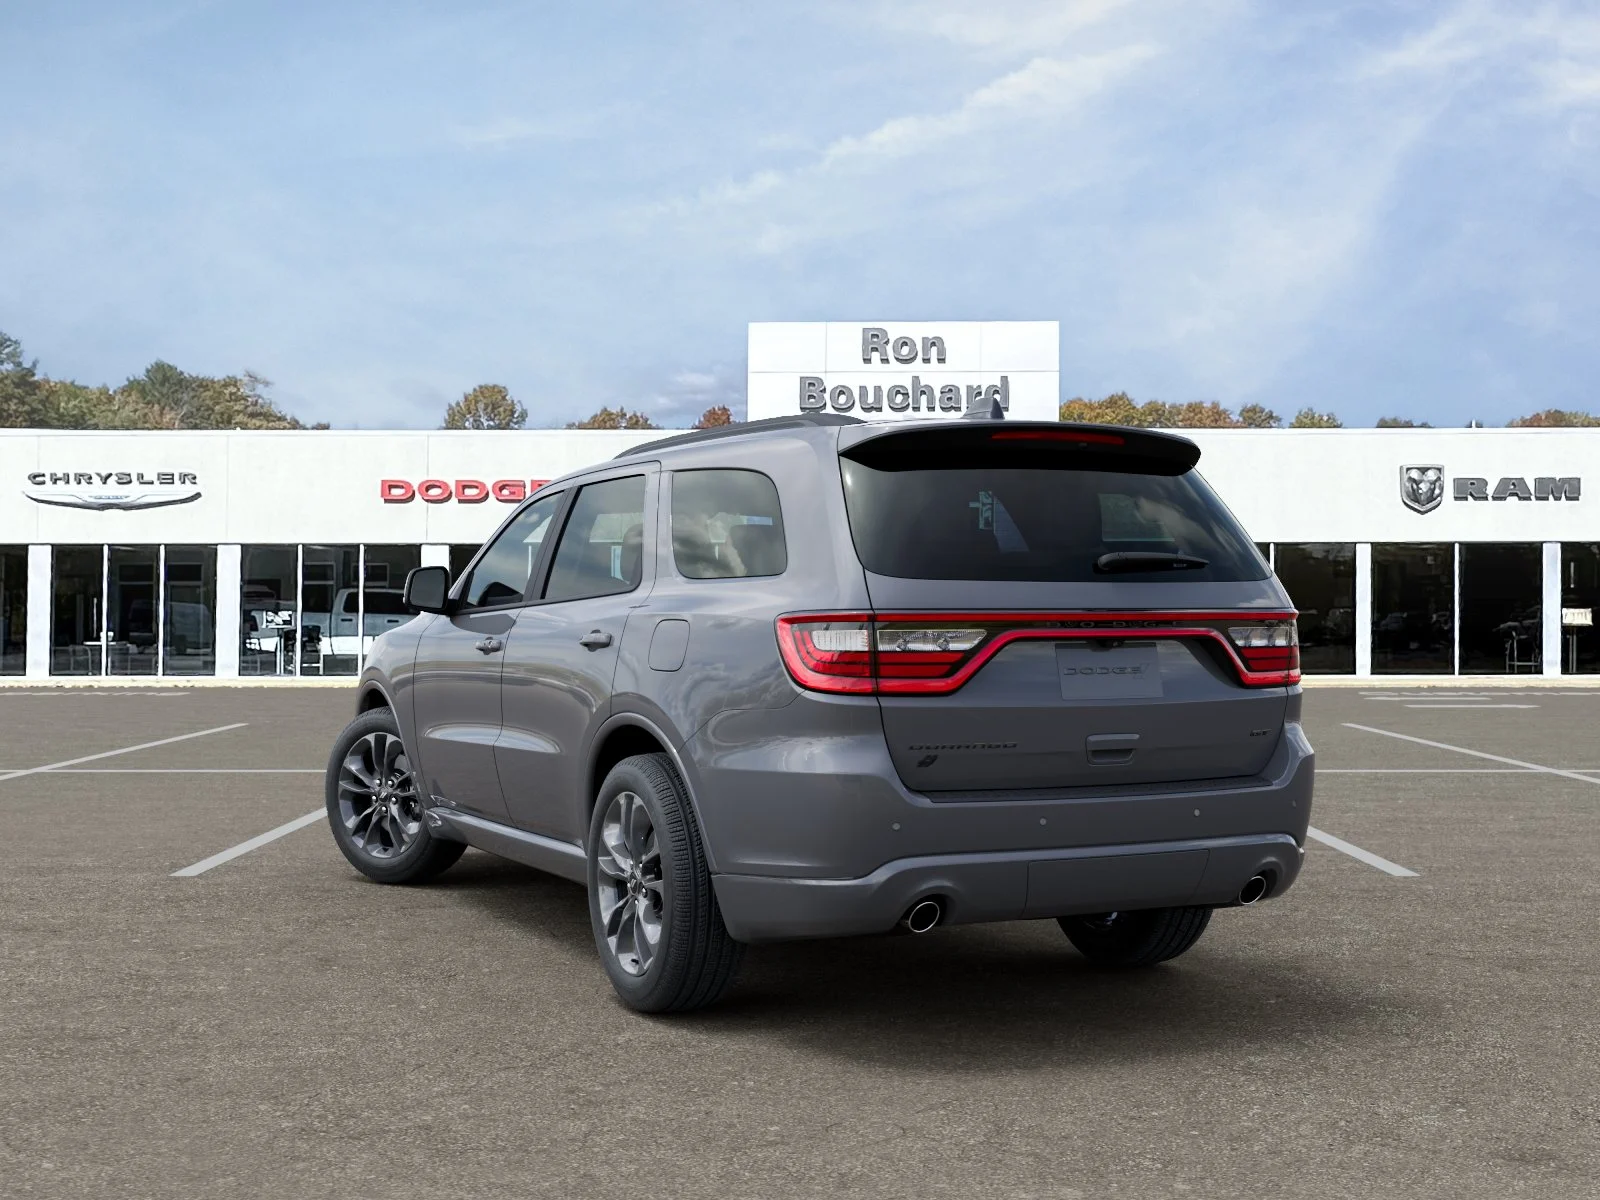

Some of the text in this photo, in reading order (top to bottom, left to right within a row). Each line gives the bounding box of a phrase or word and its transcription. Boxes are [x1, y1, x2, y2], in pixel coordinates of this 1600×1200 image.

[862, 327, 946, 364] Ron
[799, 375, 1009, 412] Bouchard
[27, 472, 198, 485] CHRYSLER
[1453, 477, 1581, 501] RAM
[1063, 666, 1141, 675] DODGE
